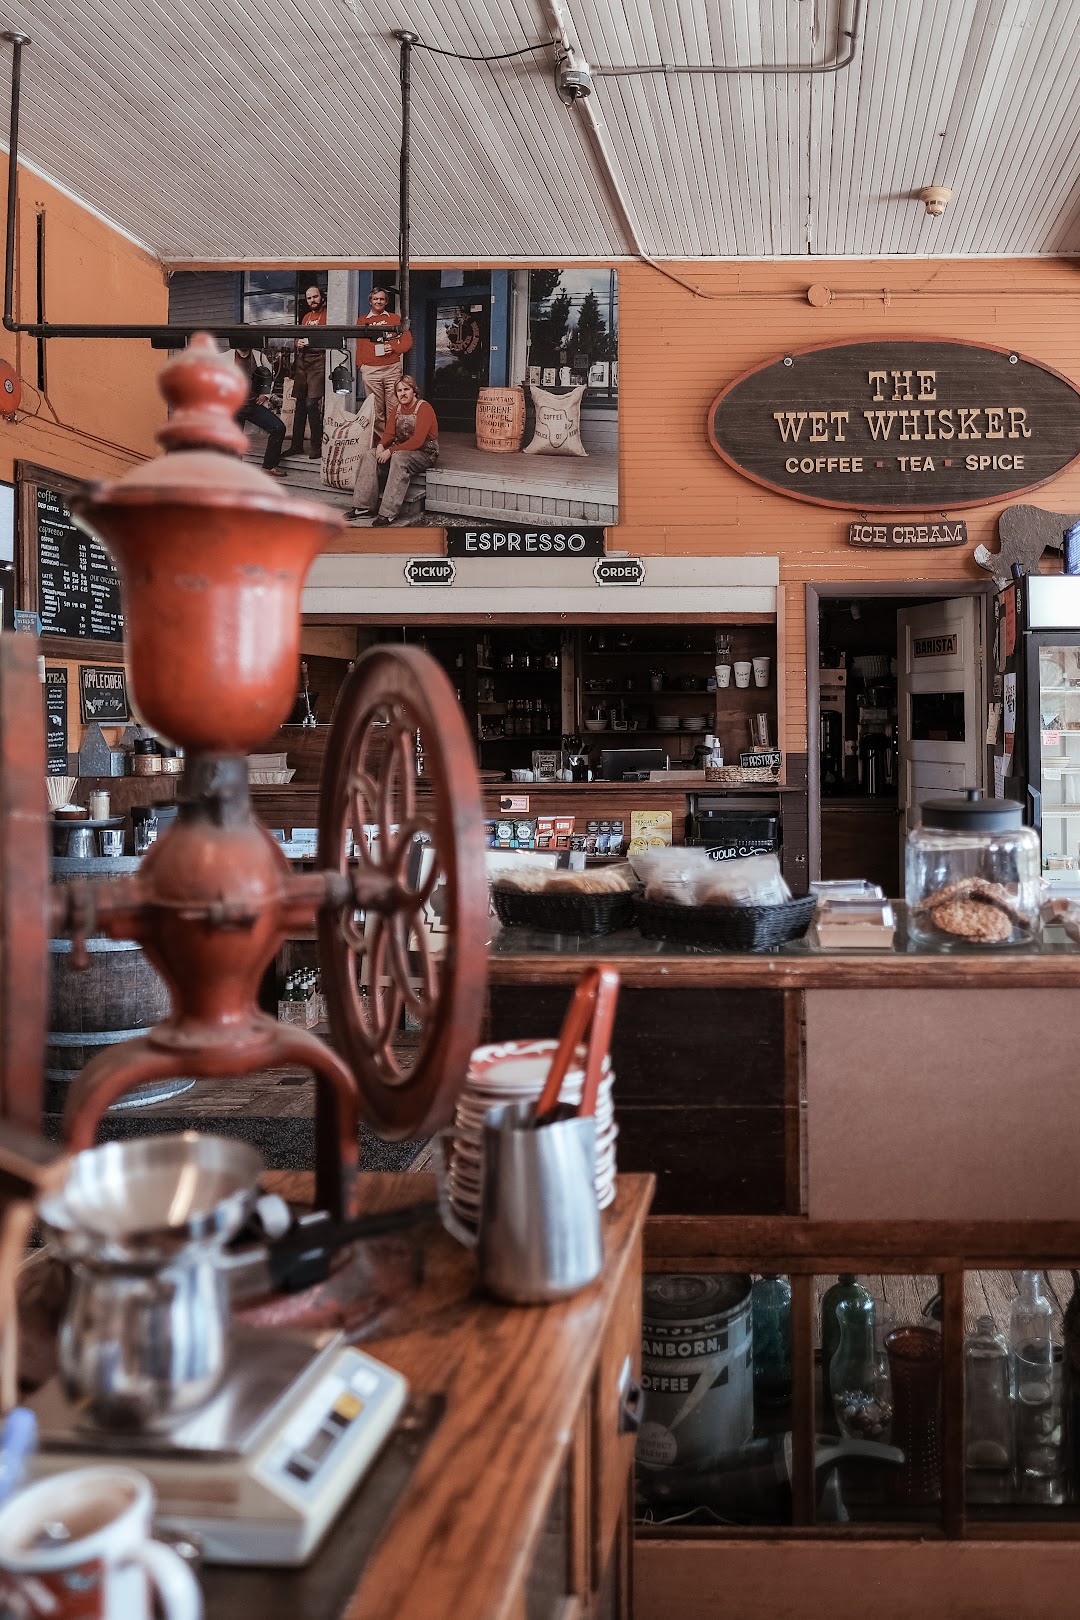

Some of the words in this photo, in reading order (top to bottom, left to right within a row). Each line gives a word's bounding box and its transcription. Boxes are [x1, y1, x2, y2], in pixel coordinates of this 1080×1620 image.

[868, 370, 937, 401] THE
[774, 411, 849, 443] WET
[864, 408, 1032, 441] WHISKER
[785, 458, 864, 473] COFFEE
[898, 456, 935, 472] TEA
[965, 454, 1024, 470] SPICE
[38, 490, 58, 502] coffee
[38, 525, 64, 536] espresso
[853, 524, 887, 543] ICE
[892, 524, 962, 543] CREAM
[465, 532, 586, 551] ESPRESSO
[411, 567, 450, 577] PICKUP
[600, 568, 640, 577] ORDER
[915, 638, 954, 654] BARISTA
[46, 672, 66, 684] TEA
[85, 674, 104, 688] APPLE
[104, 674, 123, 690] CIDER
[713, 848, 737, 861] YOUR
